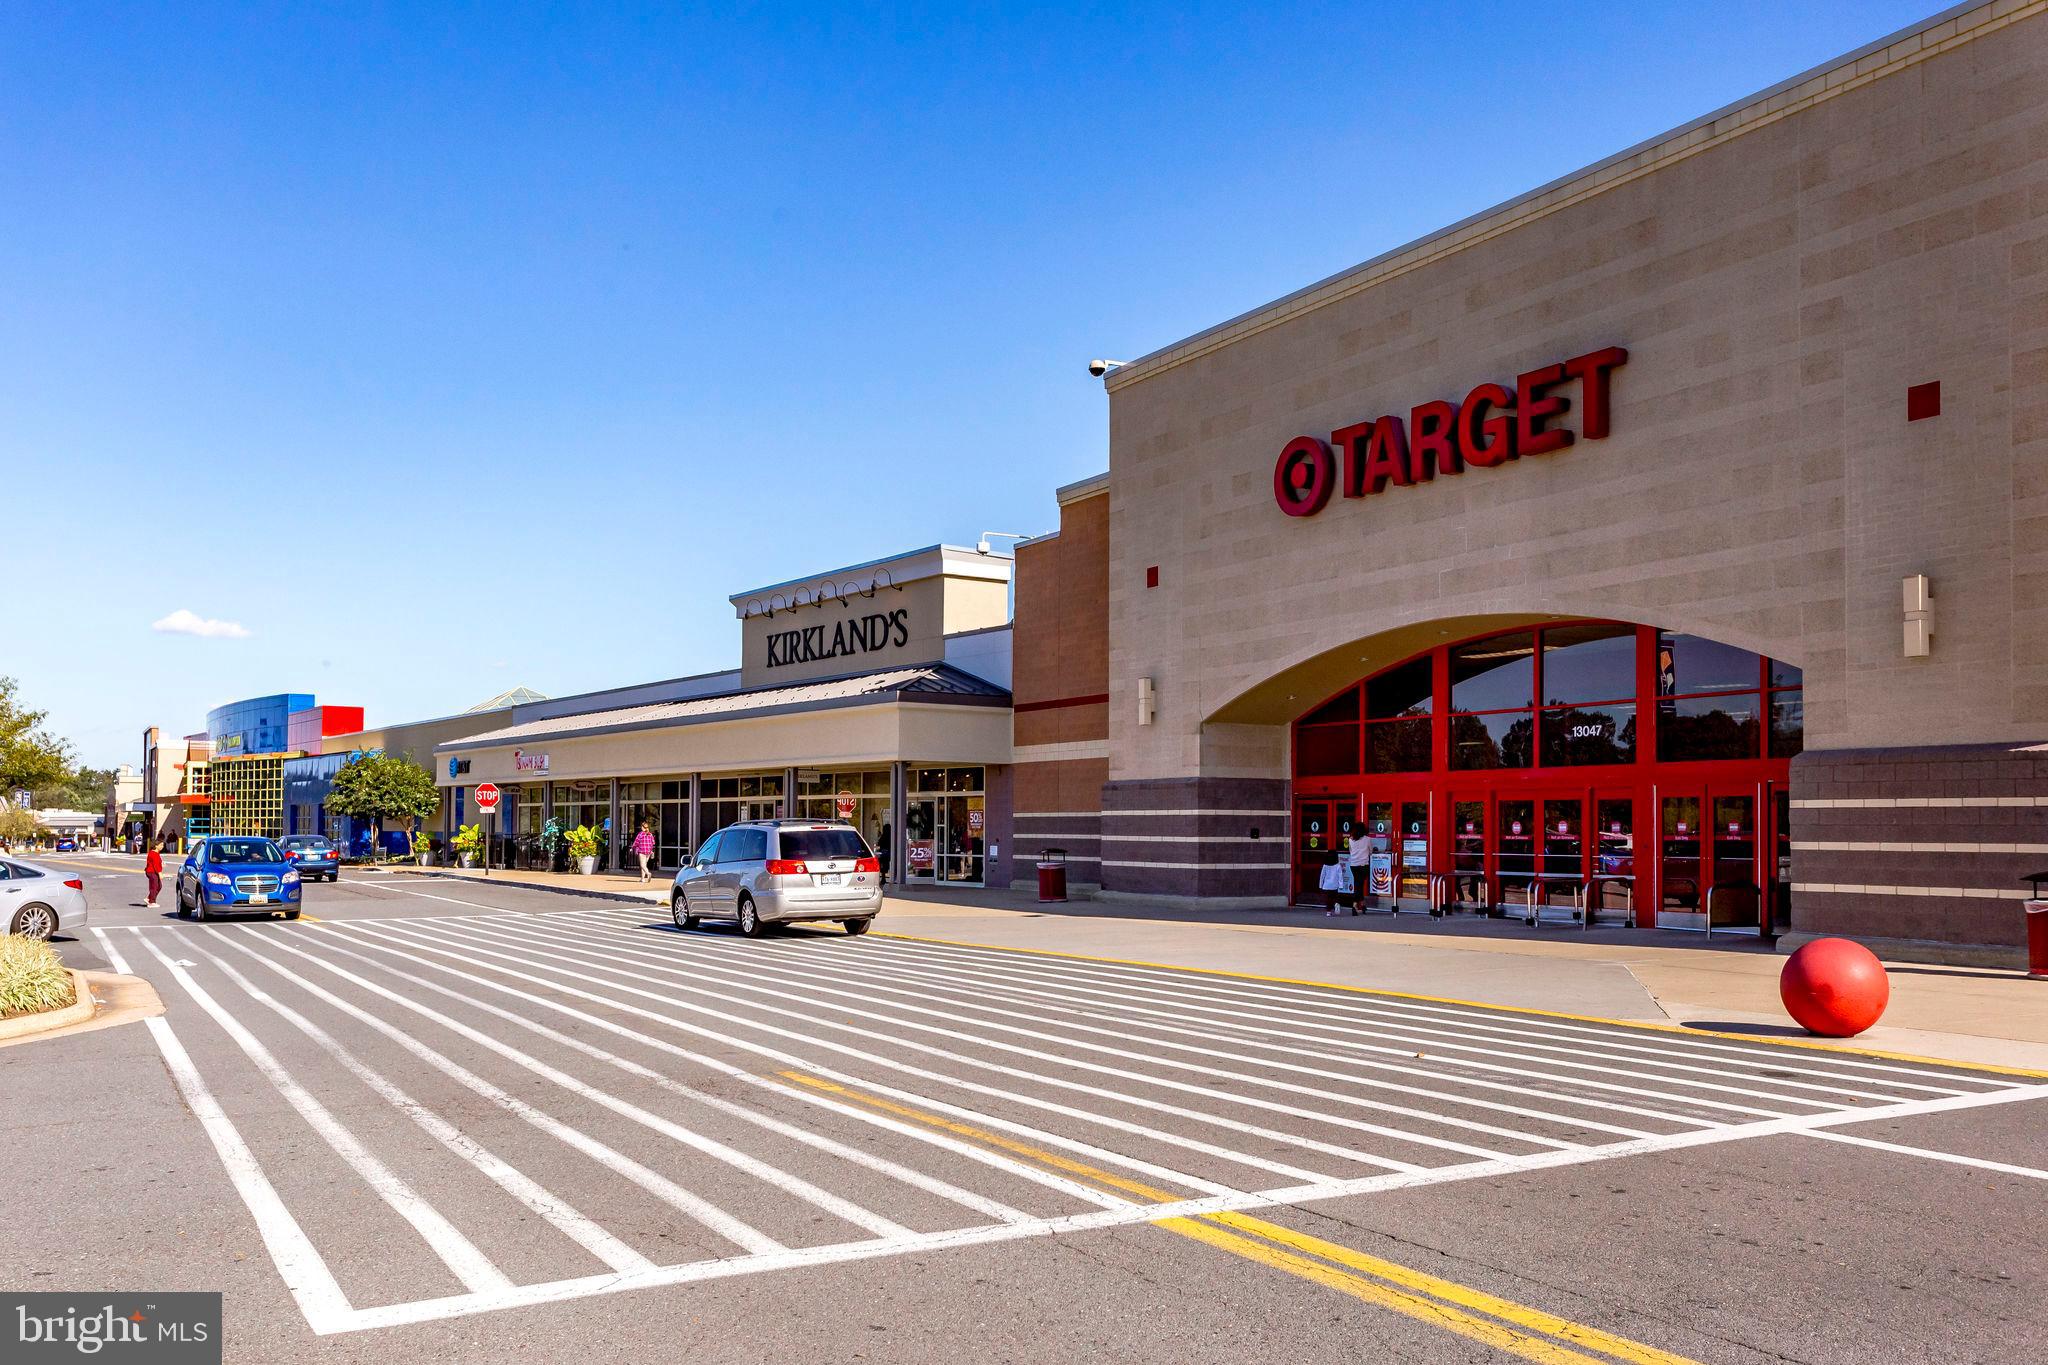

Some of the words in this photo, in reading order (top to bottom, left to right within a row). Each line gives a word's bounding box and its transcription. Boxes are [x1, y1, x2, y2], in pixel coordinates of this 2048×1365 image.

[1331, 346, 1628, 498] TARGET
[766, 608, 909, 669] KIRKLAND'S
[1572, 725, 1602, 737] 13047
[477, 791, 498, 800] STOP
